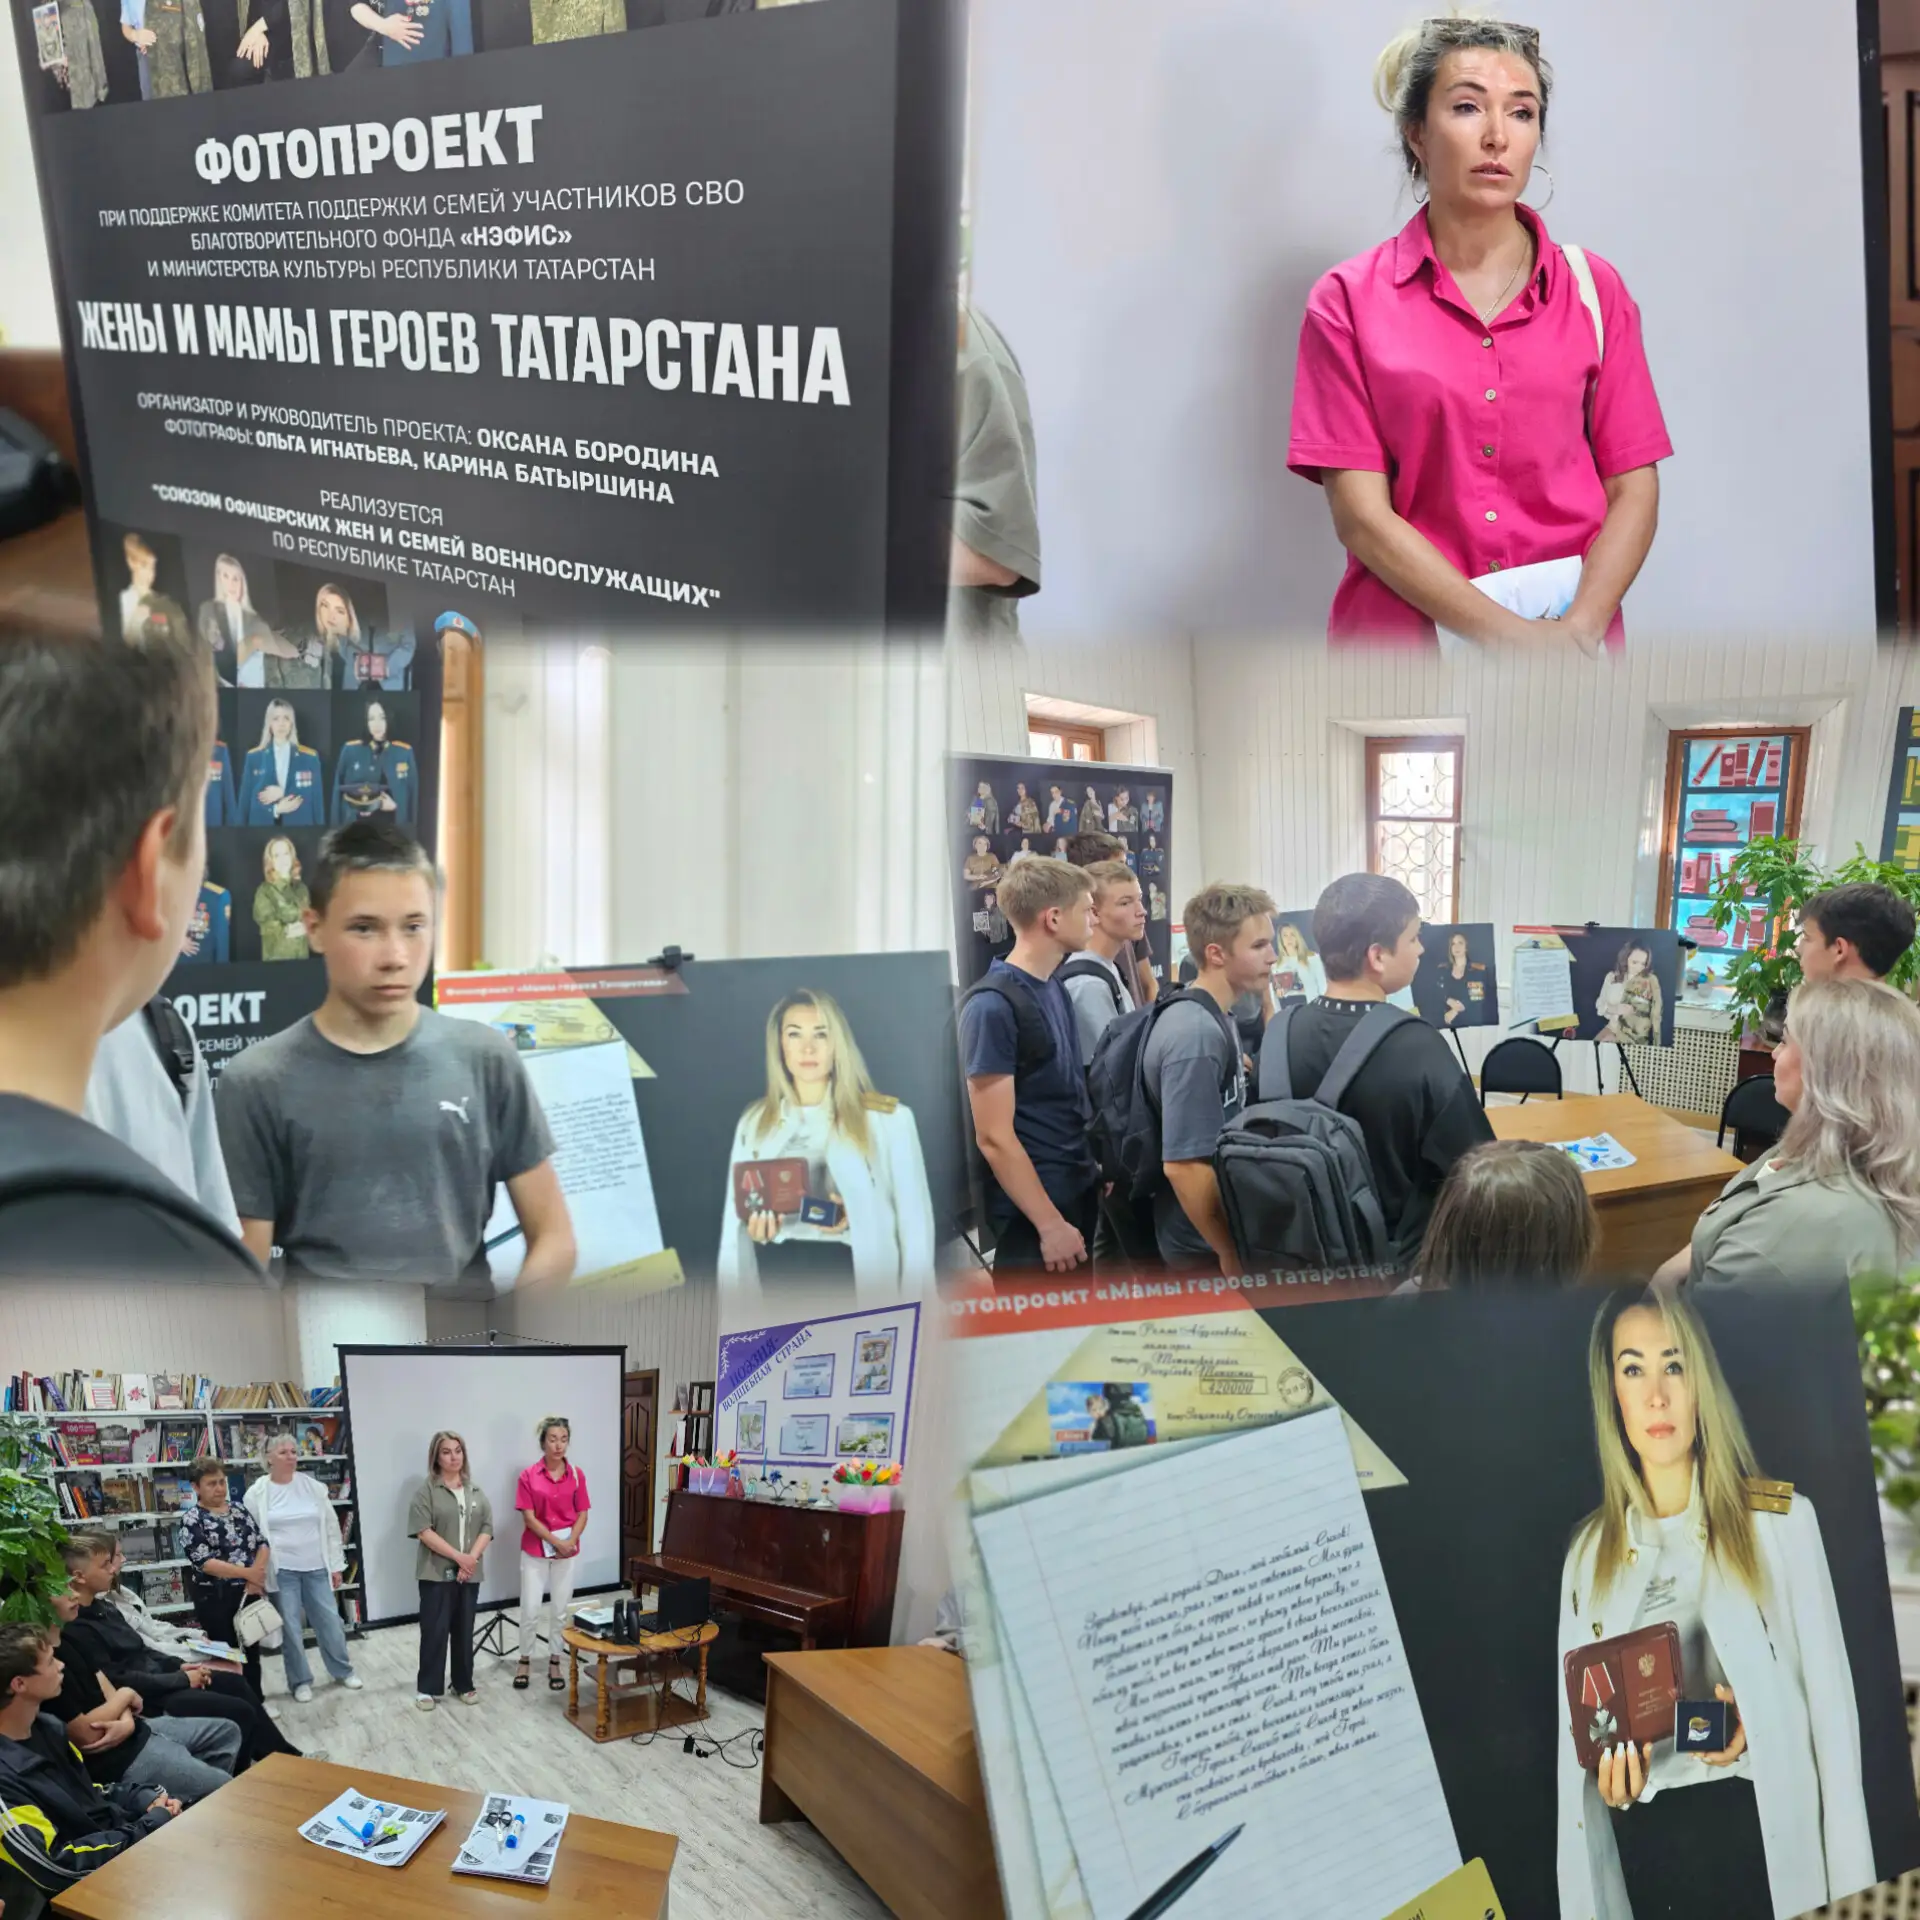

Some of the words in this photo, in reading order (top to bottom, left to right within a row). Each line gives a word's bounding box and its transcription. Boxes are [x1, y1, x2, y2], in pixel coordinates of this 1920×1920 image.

[195, 104, 543, 185] ФОТОПРОЕКТ
[99, 209, 127, 227] ПРИ
[129, 204, 221, 227] ПОДДЕРЖКЕ
[223, 201, 304, 223] КОМИТЕТА
[307, 195, 427, 221] ПОДДЕРЖКИ
[433, 187, 506, 215] СЕМЕЙ
[512, 182, 678, 213] УЧАСТНИКОВ
[685, 179, 745, 207] СВО
[191, 228, 377, 251] БЛАГОТВОРИТЕЛЬНОГО
[382, 226, 456, 250] ФОНДА
[460, 223, 573, 248] «НЭФИС»
[147, 260, 159, 277] И
[162, 260, 280, 278] МИНИСТЕРСТВА
[283, 259, 376, 279] КУЛЬТУРЫ
[381, 258, 518, 280] РЕСПУБЛИКИ
[524, 257, 656, 281] ТАТАРСТАН
[77, 300, 168, 353] ЖЕНЫ
[172, 303, 199, 355] И
[204, 304, 321, 365] МАМЫ
[329, 309, 481, 375] ГЕРОЕВ
[491, 313, 851, 406] ТАТАРСТАНА
[137, 391, 234, 417] ОРГАНИЗАТОР
[236, 402, 248, 420] И
[251, 403, 379, 435] РУКОВОДИТЕЛЬ
[383, 417, 472, 446] ПРОЕКТА:
[476, 427, 569, 458] ОКСАНА
[575, 438, 720, 478] БОРОДИНА
[164, 418, 254, 446] ФОТОГРАФЫ:
[255, 430, 307, 454] ОЛЬГА
[310, 437, 418, 471] ИГНАТЬЕВА,
[423, 450, 509, 481] КАРИНА
[515, 463, 675, 505] БАТЫРШИНА
[319, 489, 444, 526] РЕАЛИЗУЕТСЯ
[152, 483, 222, 511] "СОЮЗОМ
[224, 495, 330, 534] ОФИЦЕРСКИХ
[335, 517, 375, 541] ЖЕН
[380, 526, 393, 546] И
[398, 529, 465, 558] СЕМЕЙ
[471, 542, 721, 608] ВОЕННОСЛУЖАЩИХ"
[272, 530, 295, 551] ПО
[298, 536, 408, 575] РЕСПУБЛИКЕ
[411, 558, 516, 598] ТАТАРСТАН
[173, 991, 267, 1026] ОЕКТ
[197, 1034, 243, 1052] СЕМЕЙ
[950, 1287, 1089, 1316] отопроект
[1095, 1279, 1182, 1301] «Мамы
[1187, 1272, 1268, 1295] героев
[722, 1362, 772, 1412] ВОЛШЕБНАЯ
[775, 1328, 813, 1364] СТРАНА
[1208, 1379, 1254, 1395] 420000
